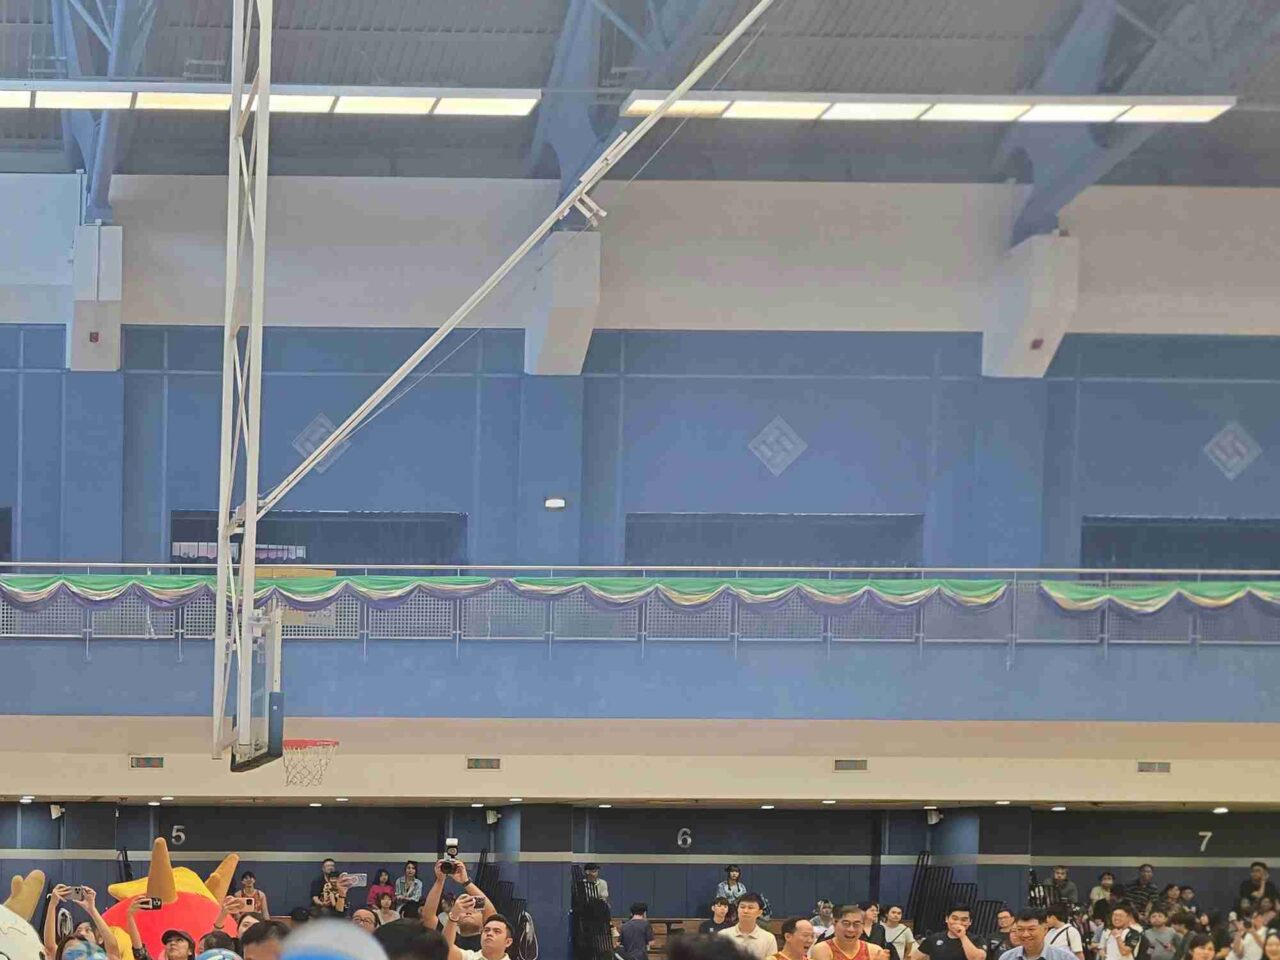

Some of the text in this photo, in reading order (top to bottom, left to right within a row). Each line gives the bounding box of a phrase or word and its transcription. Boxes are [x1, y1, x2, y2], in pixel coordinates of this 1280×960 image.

[171, 825, 186, 846] 5
[677, 827, 692, 848] 6
[1198, 831, 1213, 852] 7
